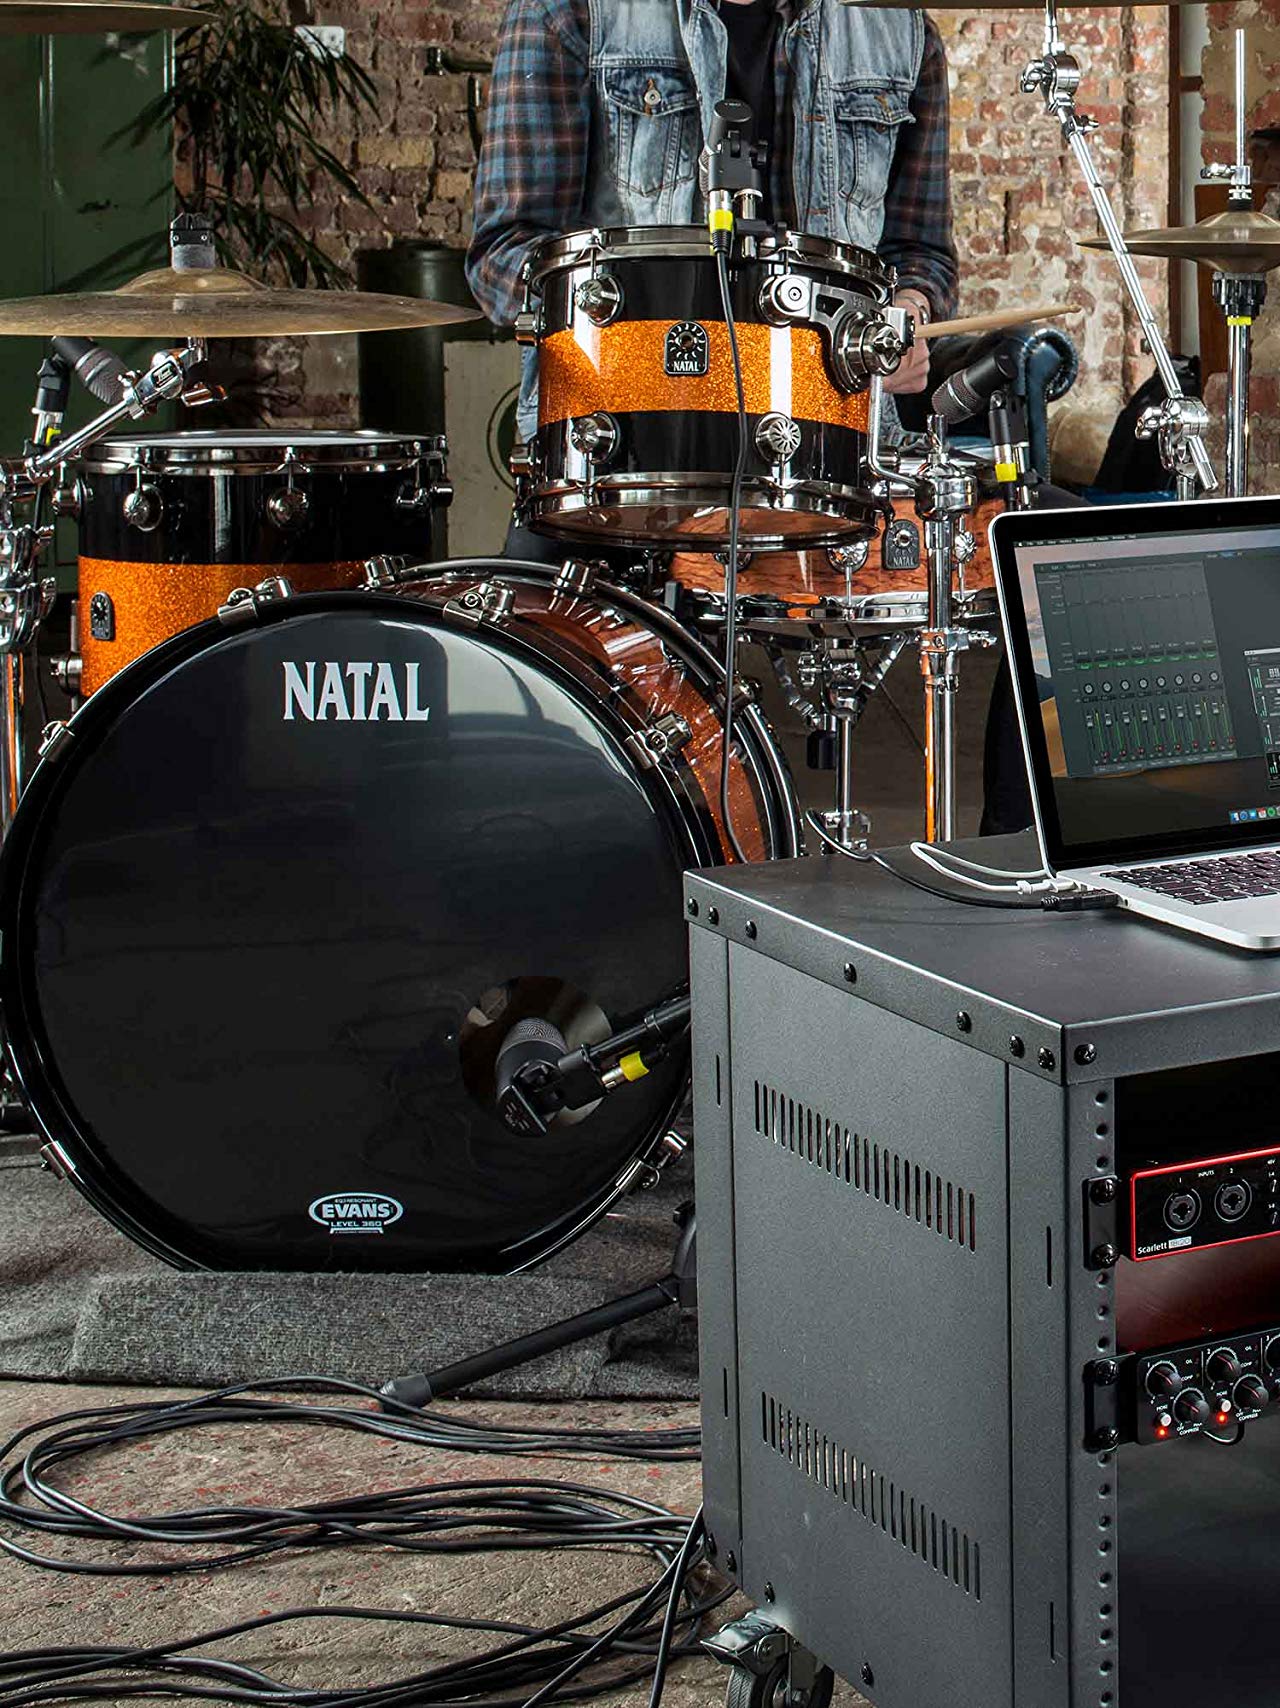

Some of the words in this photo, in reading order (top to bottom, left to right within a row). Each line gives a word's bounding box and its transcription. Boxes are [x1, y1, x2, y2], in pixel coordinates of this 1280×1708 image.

[673, 361, 700, 372] NATAL
[893, 556, 915, 566] NATAL
[282, 661, 430, 721] NATAL
[1198, 1170, 1215, 1178] INPUTS
[322, 1203, 390, 1218] EVANS
[1138, 1241, 1167, 1255] Scarlett
